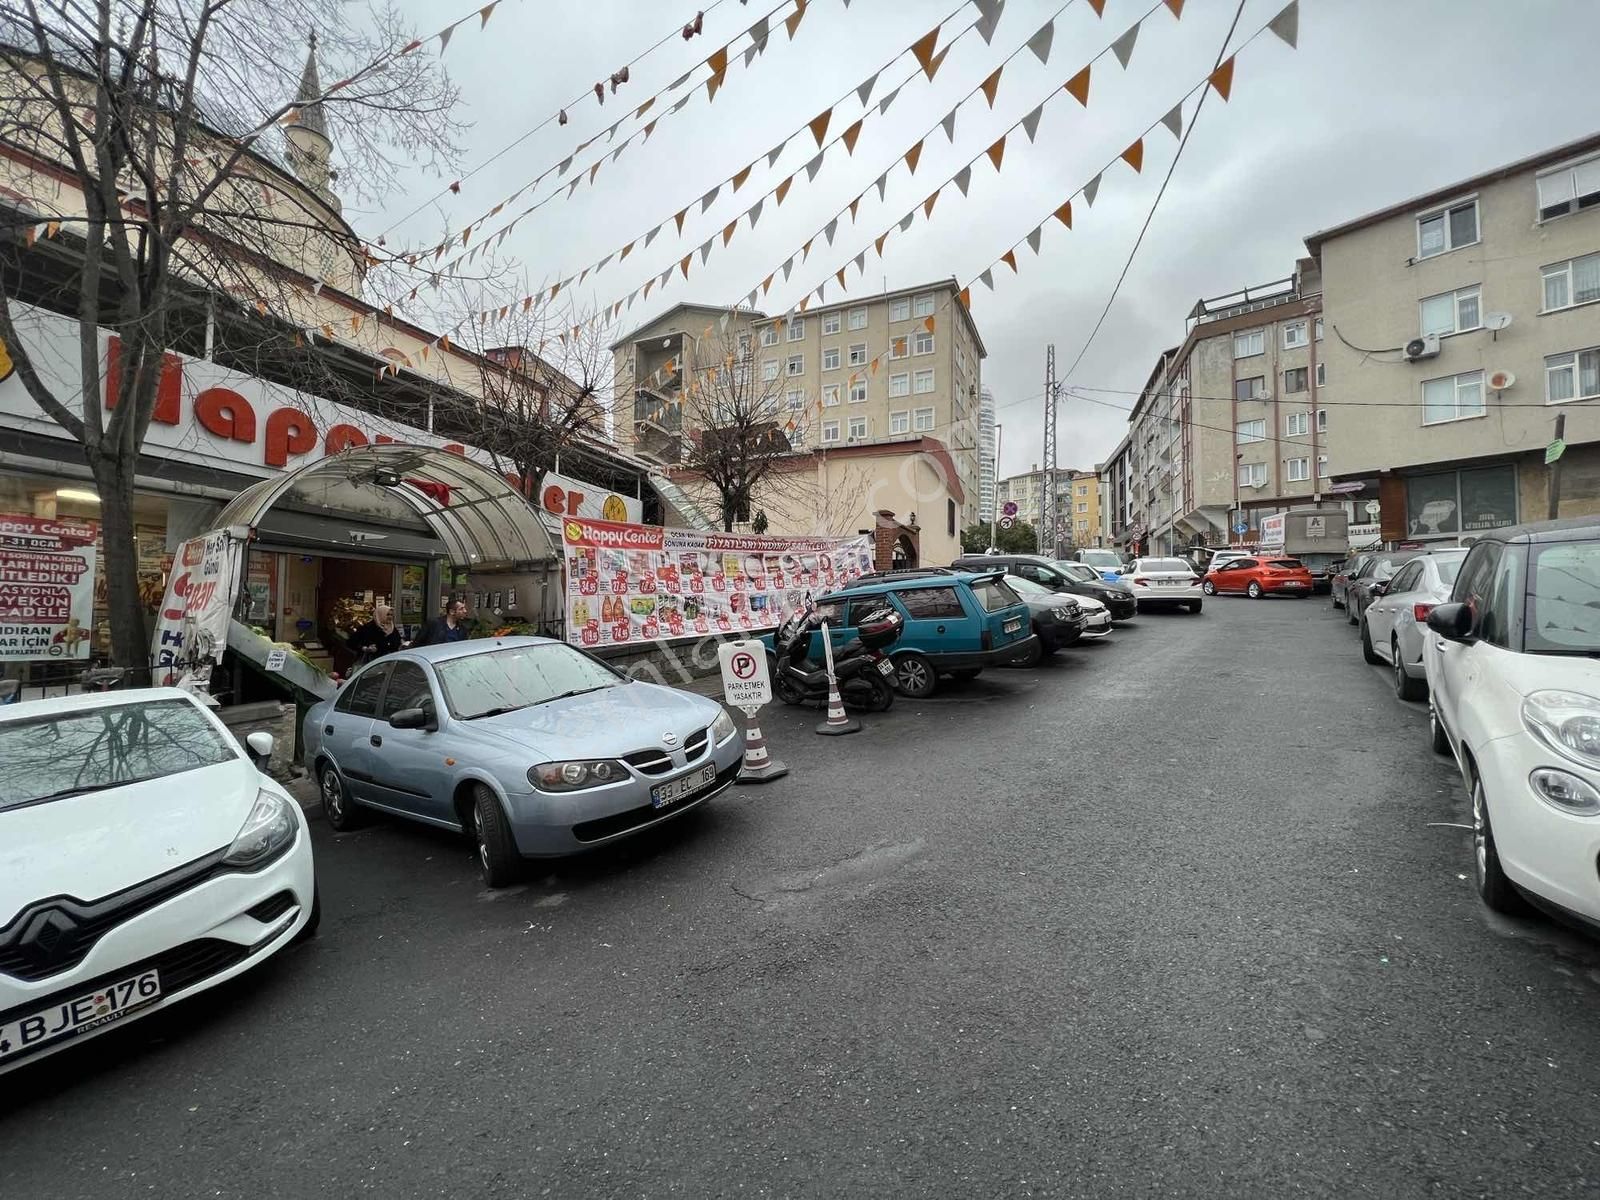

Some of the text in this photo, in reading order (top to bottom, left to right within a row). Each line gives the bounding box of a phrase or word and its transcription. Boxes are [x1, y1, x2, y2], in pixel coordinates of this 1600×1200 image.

[41, 524, 94, 537] Center
[31, 539, 63, 549] OCAK
[8, 552, 49, 561] SONUNA
[35, 560, 86, 573] İNDİRİP
[1, 586, 68, 596] ASYONLA
[21, 636, 49, 649] İÇİN
[728, 681, 766, 691] PARK ETMEK
[660, 784, 673, 799] 33
[681, 777, 692, 792] EC
[20, 995, 97, 1044] BJE
[104, 972, 157, 1010] 176
[77, 1009, 127, 1036] RENAULT
